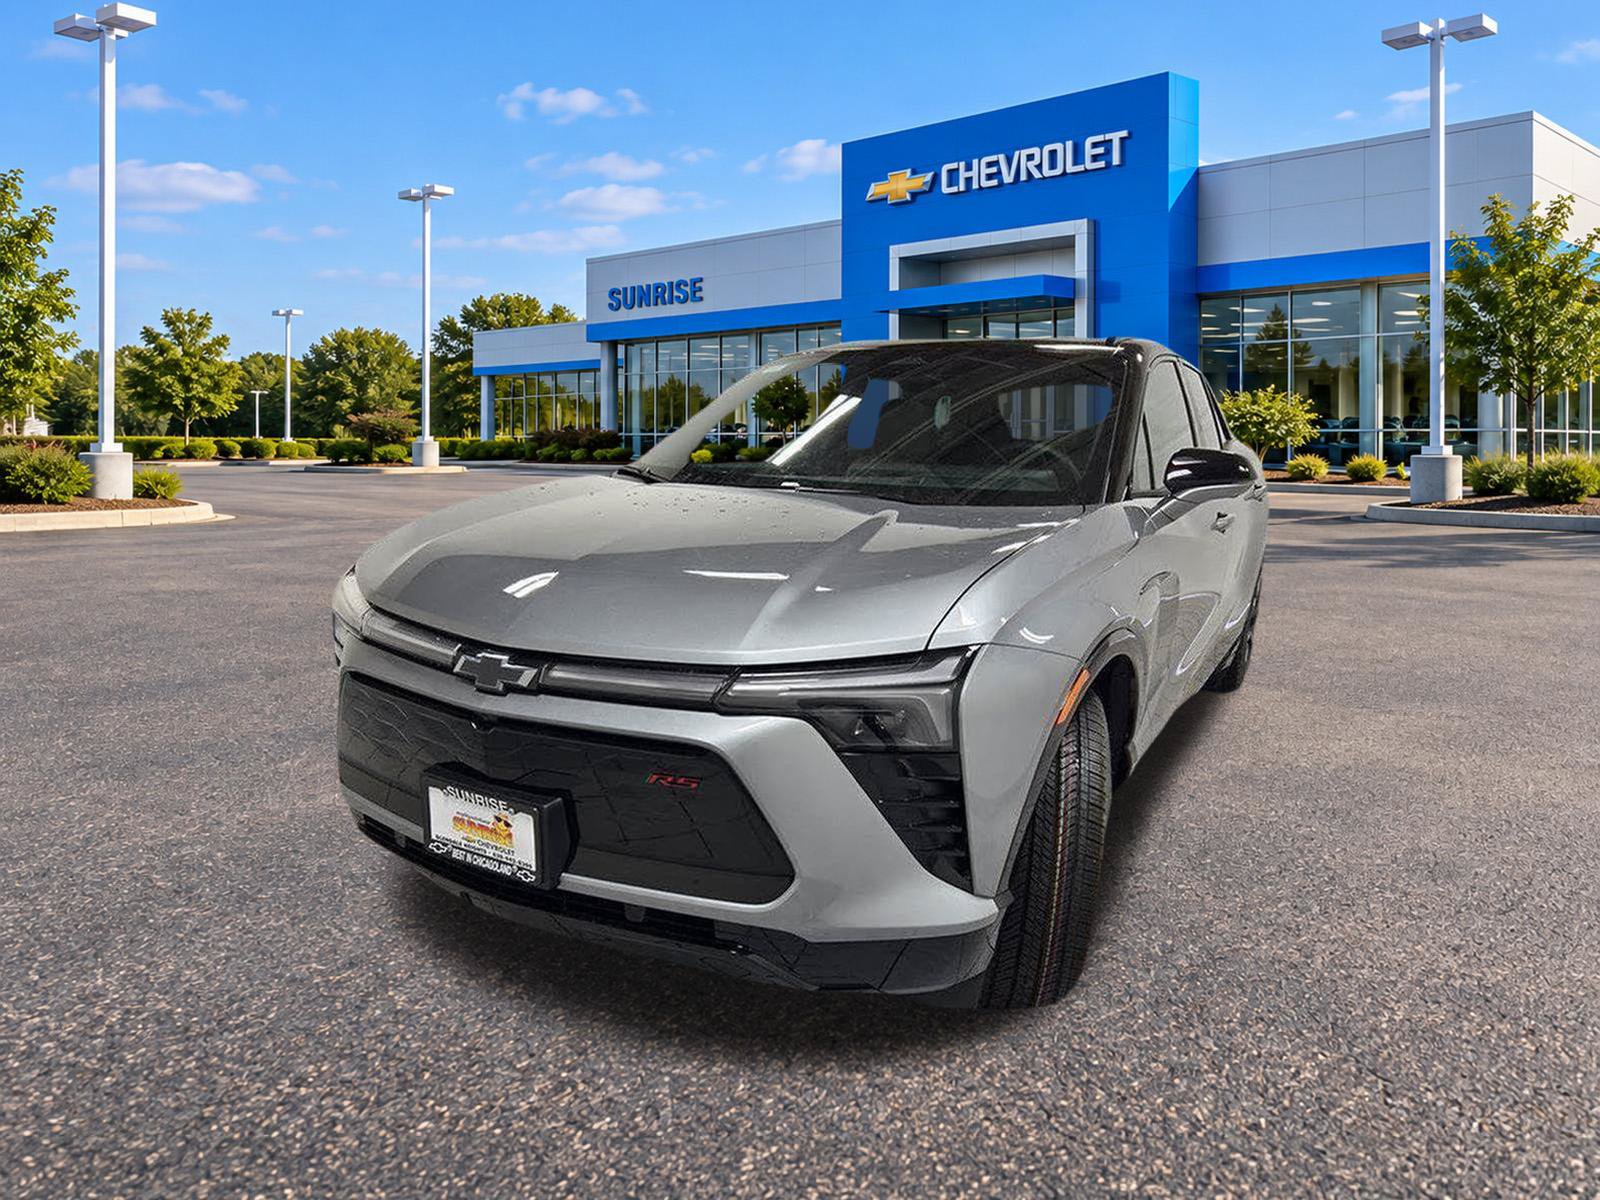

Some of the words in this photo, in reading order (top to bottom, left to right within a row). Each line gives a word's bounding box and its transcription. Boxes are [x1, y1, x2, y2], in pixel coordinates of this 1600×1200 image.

[941, 130, 1129, 194] CHEVROLET
[607, 277, 704, 312] SUNRISE
[646, 774, 700, 789] RS
[446, 785, 508, 811] SUNRISE
